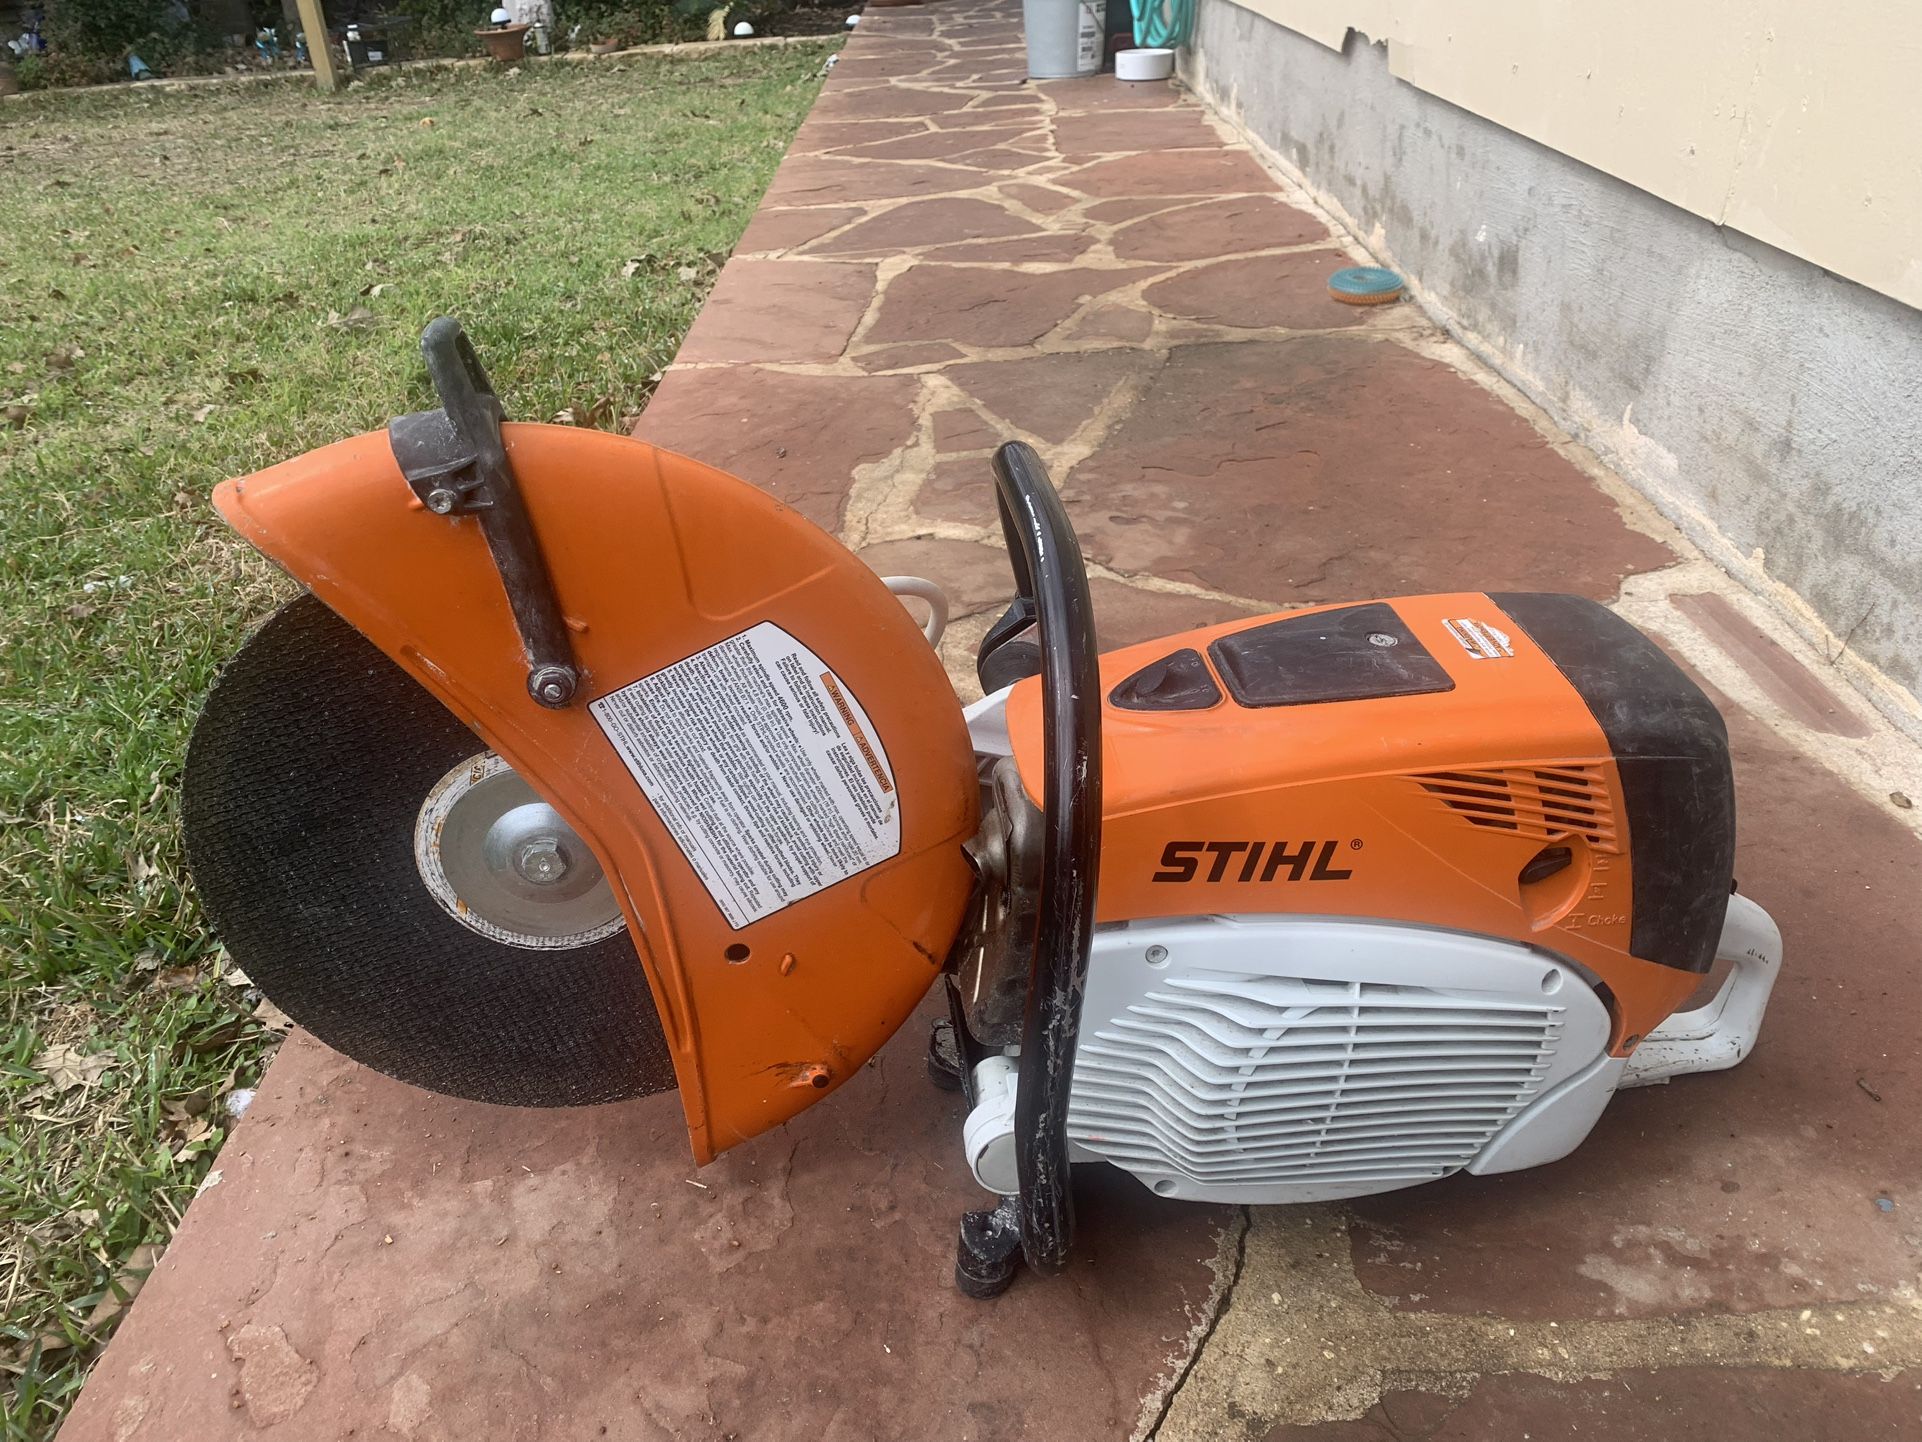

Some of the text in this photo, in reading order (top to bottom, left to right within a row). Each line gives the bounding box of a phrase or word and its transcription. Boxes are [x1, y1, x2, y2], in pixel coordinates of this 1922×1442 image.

[830, 689, 855, 726] WARNING
[858, 741, 890, 791] ADVERTENCIA
[1587, 913, 1626, 926] Choke
